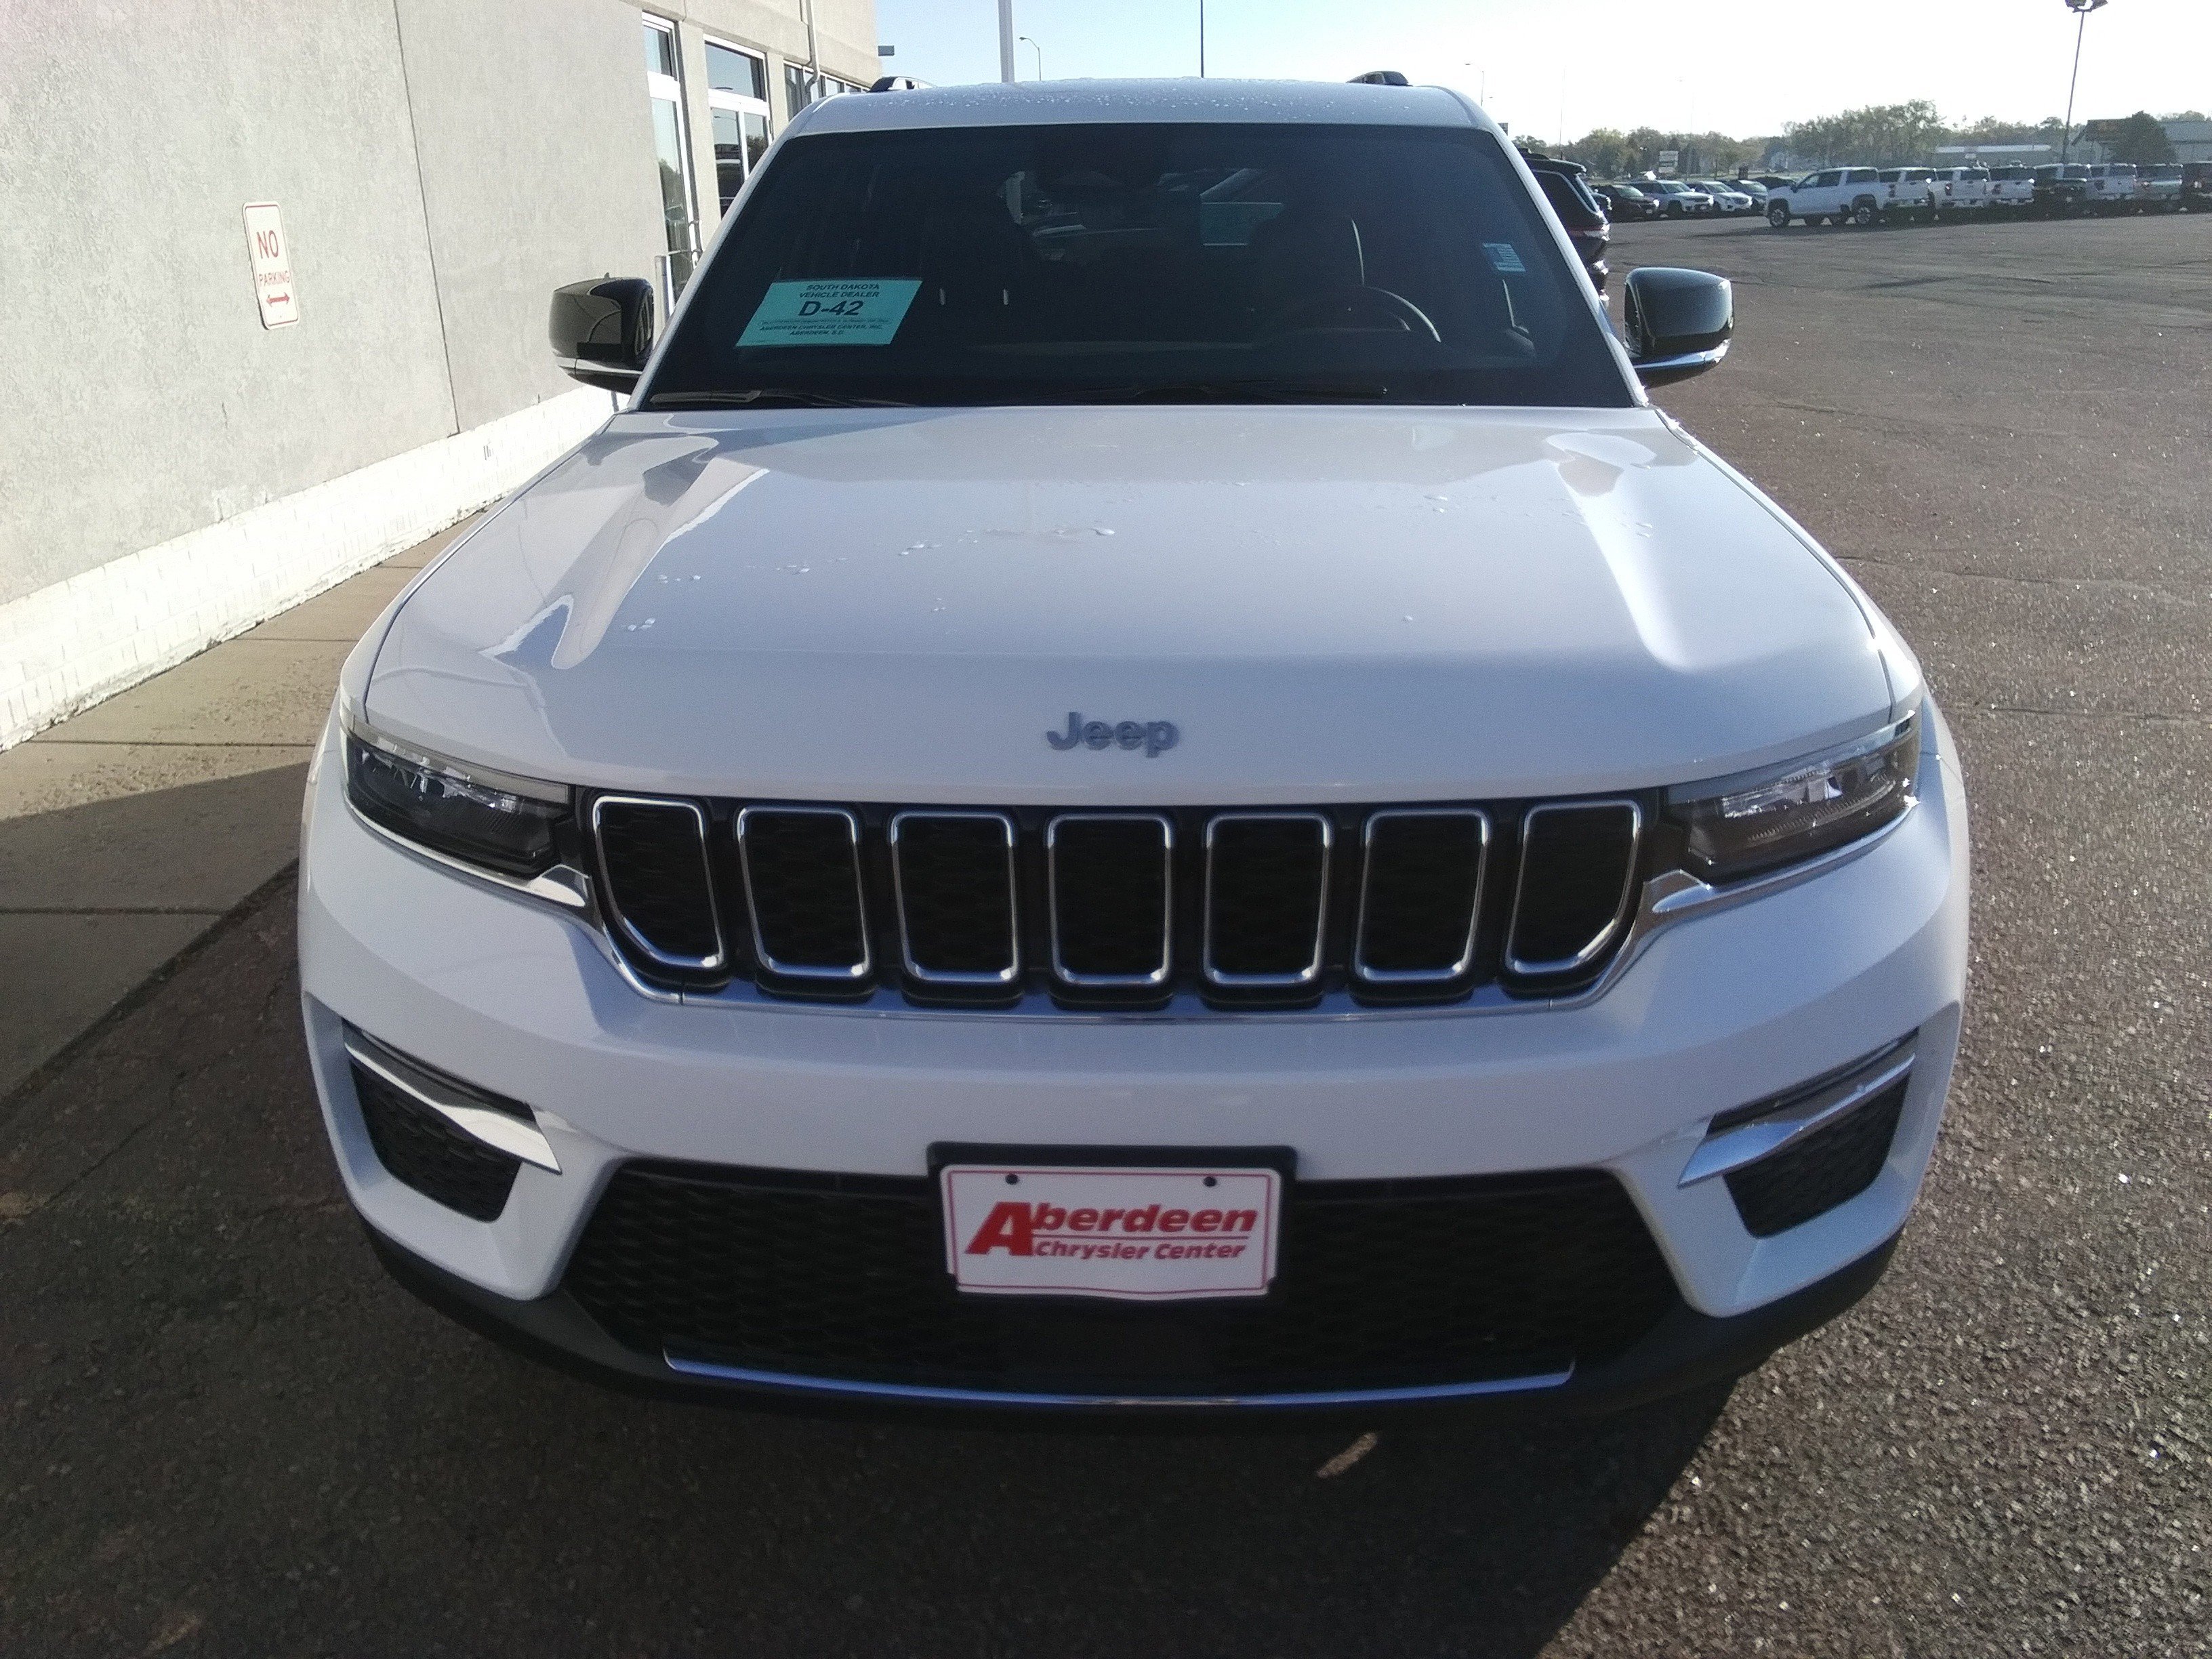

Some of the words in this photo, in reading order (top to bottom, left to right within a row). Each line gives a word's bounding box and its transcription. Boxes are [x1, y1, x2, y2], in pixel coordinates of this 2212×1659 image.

[257, 230, 279, 259] NO
[259, 270, 291, 287] PARKING
[798, 300, 864, 316] D-42
[1046, 712, 1180, 758] Jeep
[965, 1202, 1258, 1256] Aberdeen
[1035, 1241, 1151, 1260] Chrysler
[1153, 1243, 1246, 1259] Center
